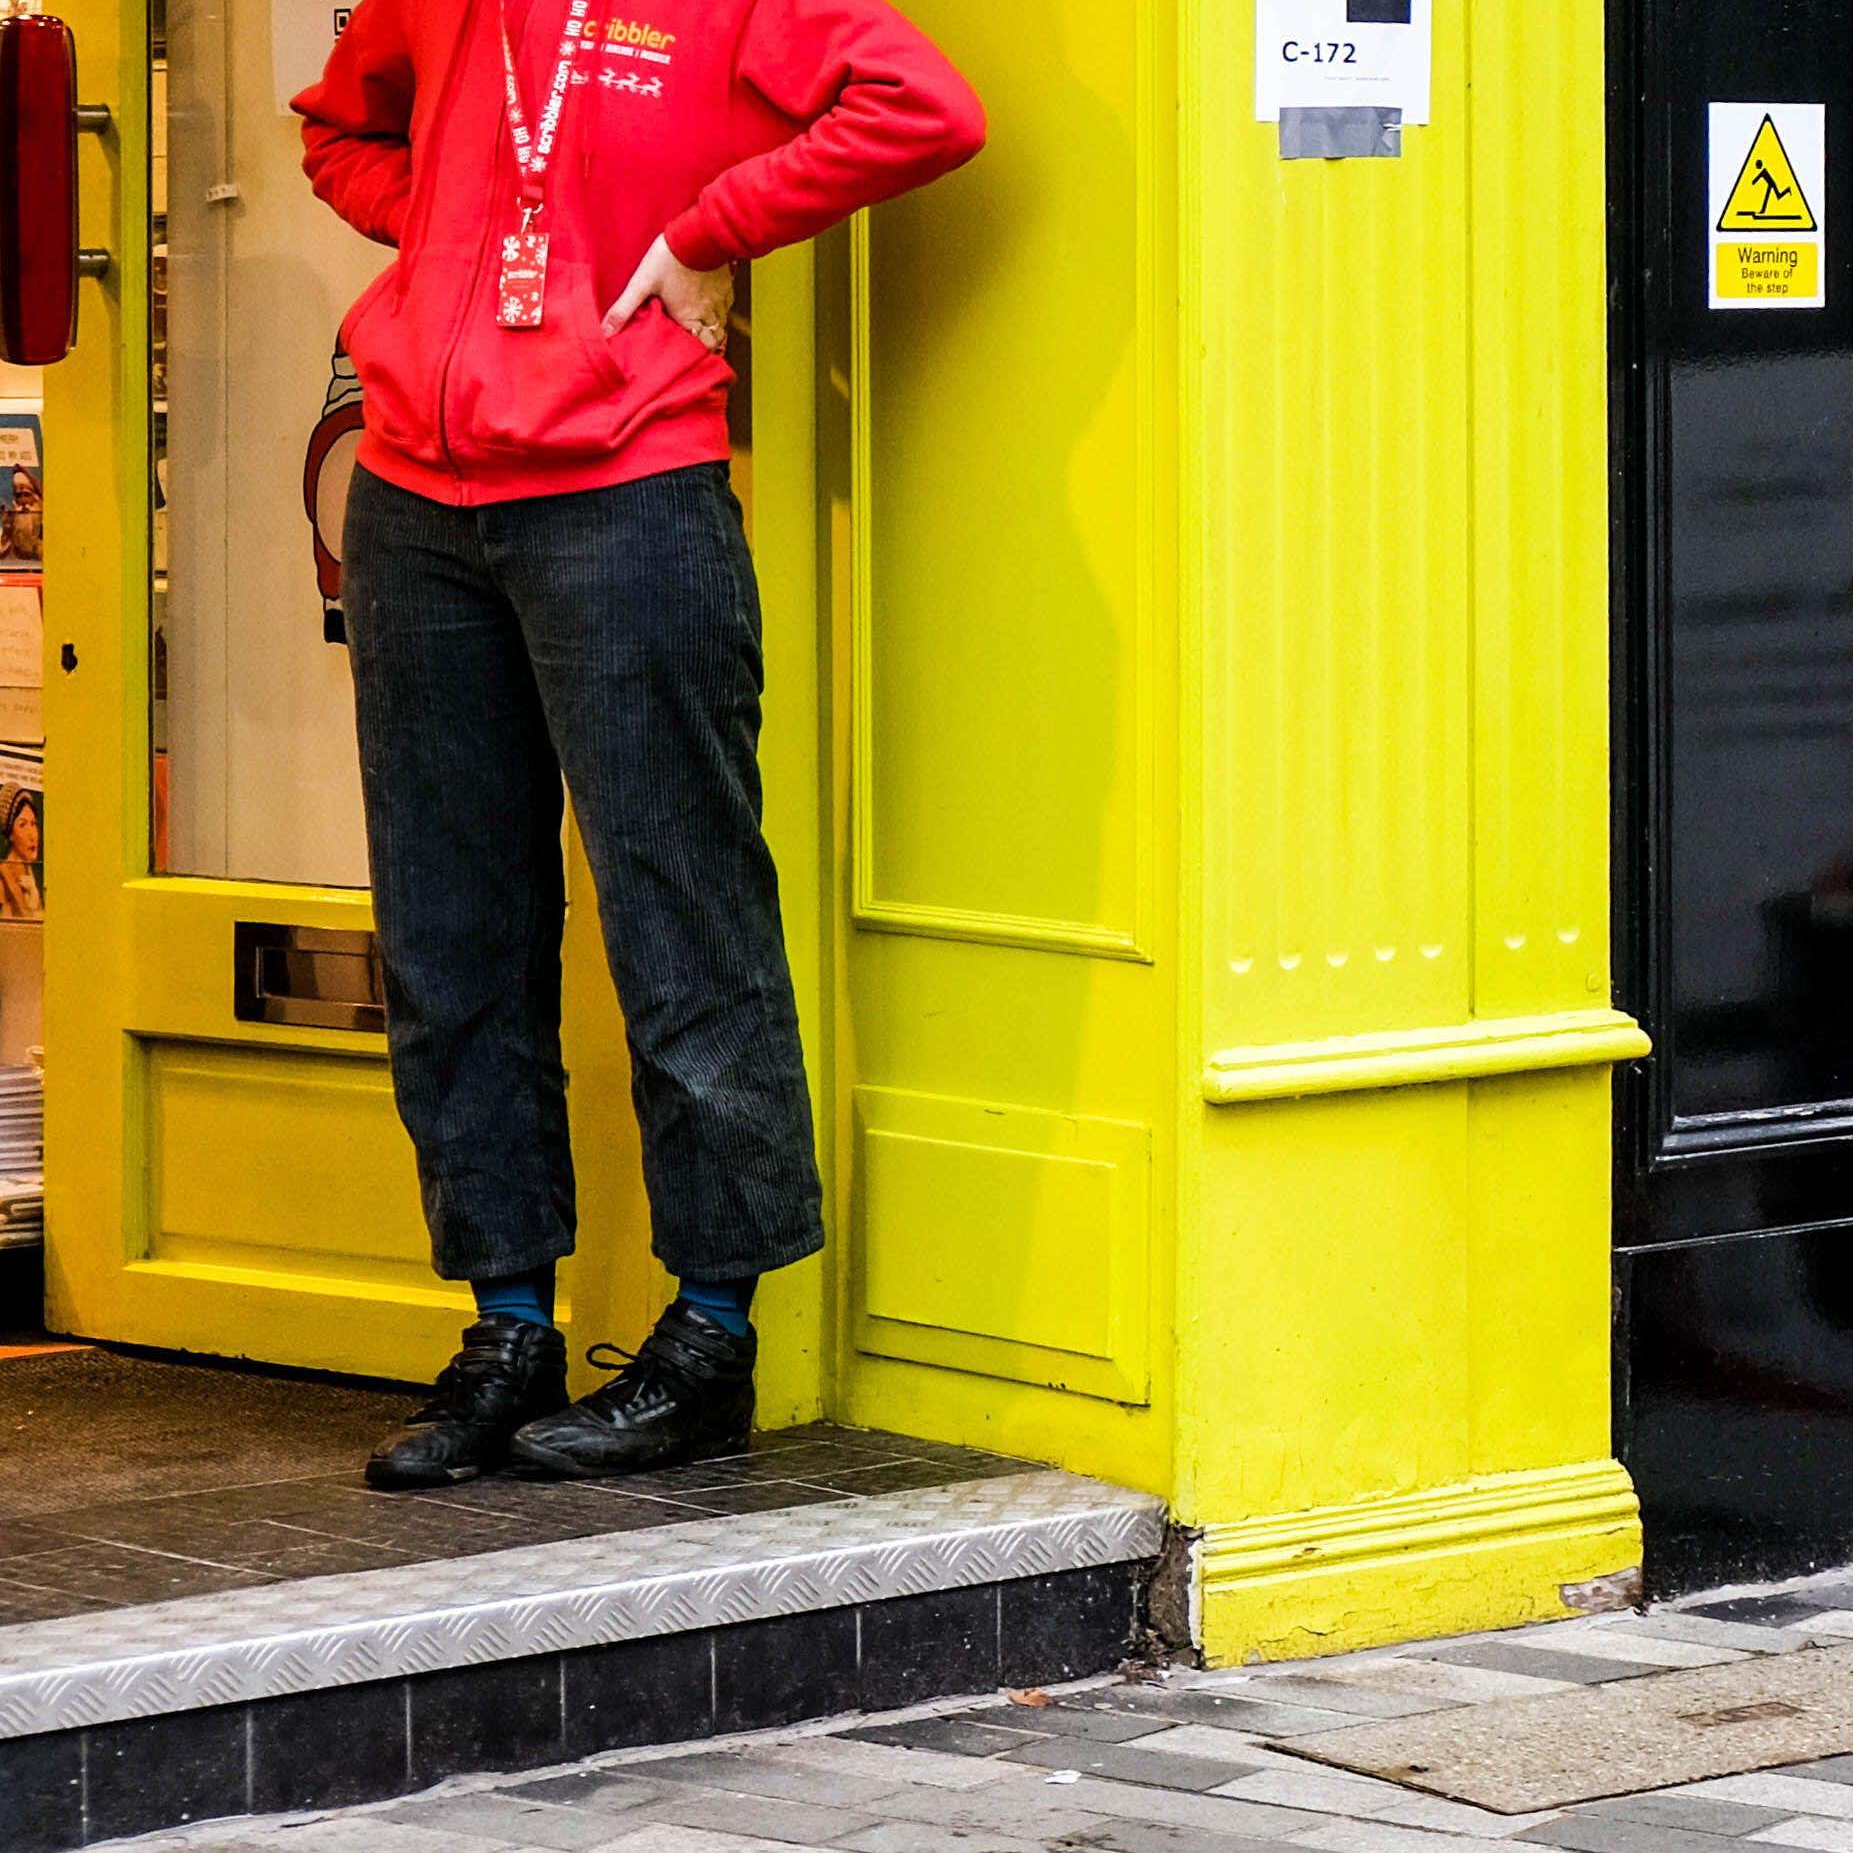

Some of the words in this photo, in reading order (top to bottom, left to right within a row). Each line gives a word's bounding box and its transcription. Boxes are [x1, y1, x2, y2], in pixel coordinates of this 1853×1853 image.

[584, 18, 676, 49] cibbler
[1282, 41, 1357, 65] C-172
[1738, 247, 1798, 267] Warning
[1741, 267, 1780, 279] Beware
[1783, 267, 1793, 279] of
[1746, 283, 1763, 293] the
[1767, 283, 1788, 294] step
